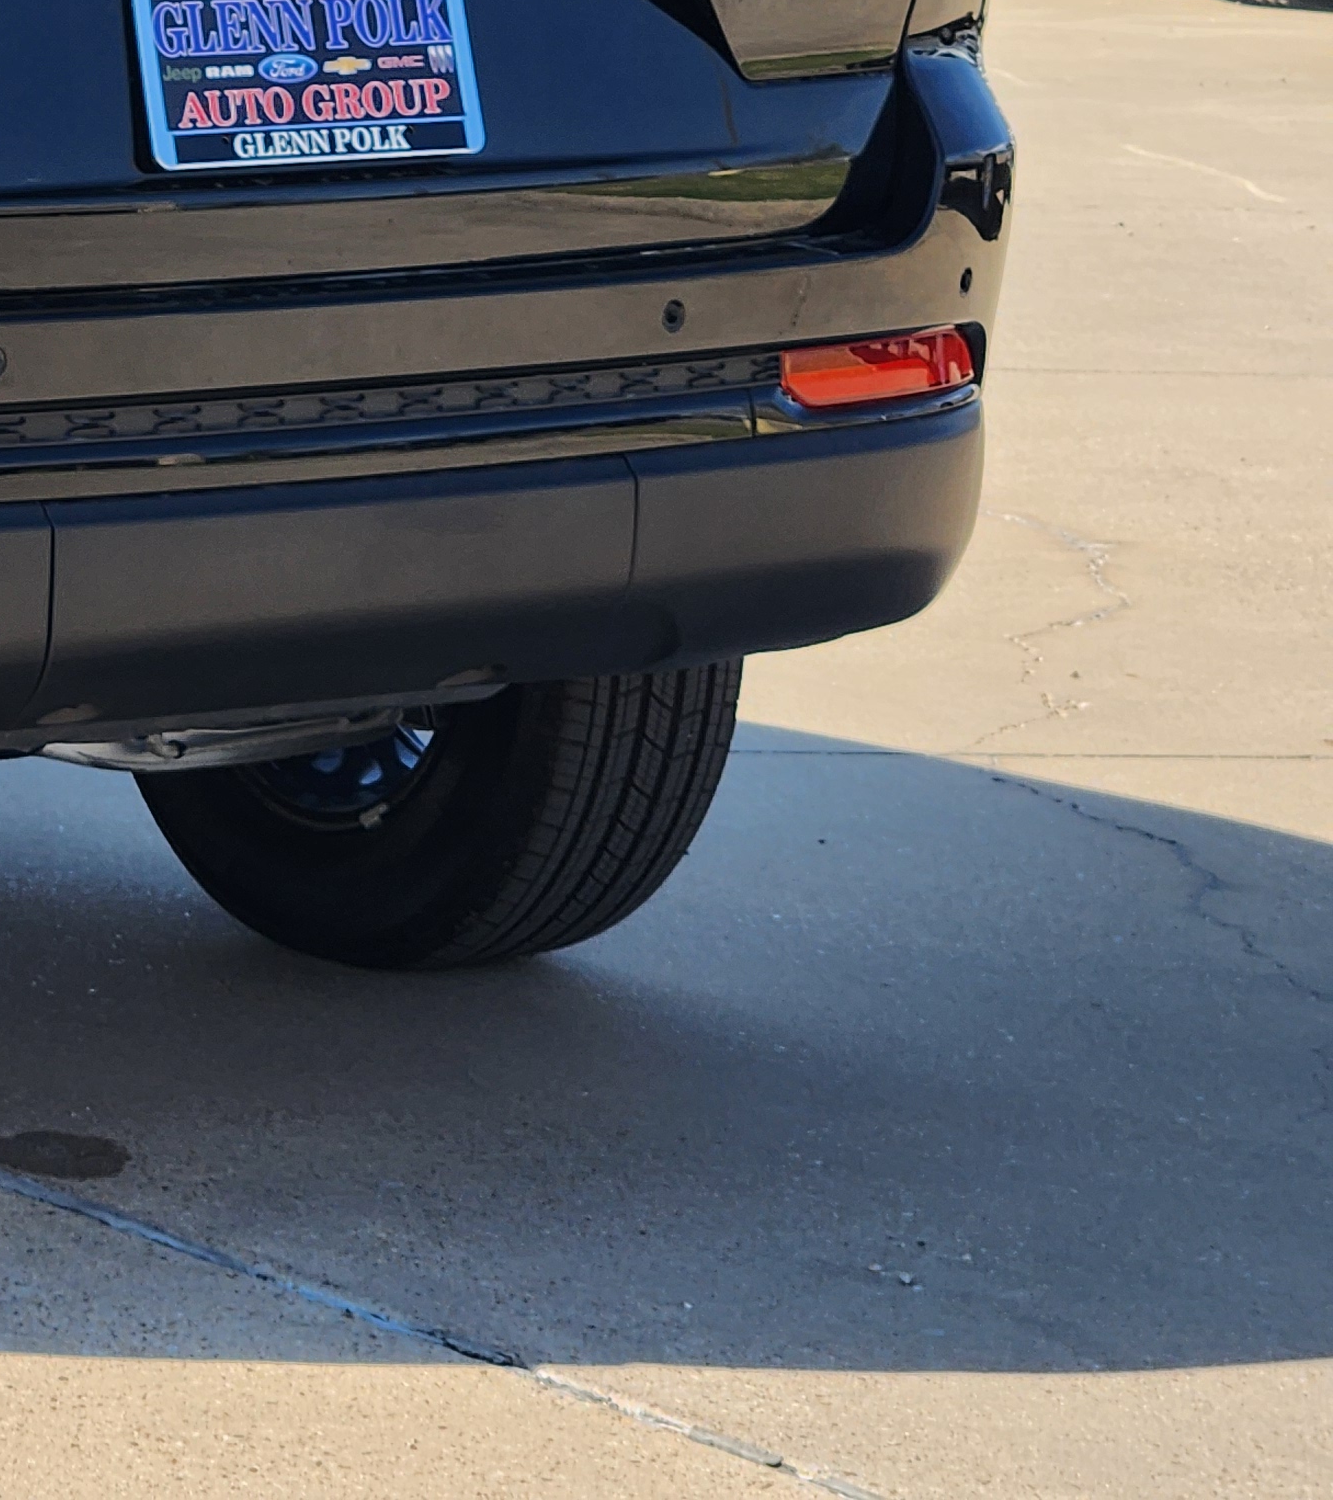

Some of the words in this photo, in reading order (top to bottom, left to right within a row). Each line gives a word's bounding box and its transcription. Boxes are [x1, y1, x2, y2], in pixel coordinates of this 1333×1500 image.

[162, 65, 203, 83] Jeep
[205, 64, 255, 79] RAM
[268, 60, 306, 80] Ford
[377, 54, 425, 69] GMC
[177, 87, 295, 130] AUTO
[301, 77, 452, 122] GROUP
[232, 130, 332, 160] GLENN
[334, 124, 413, 155] POLK
